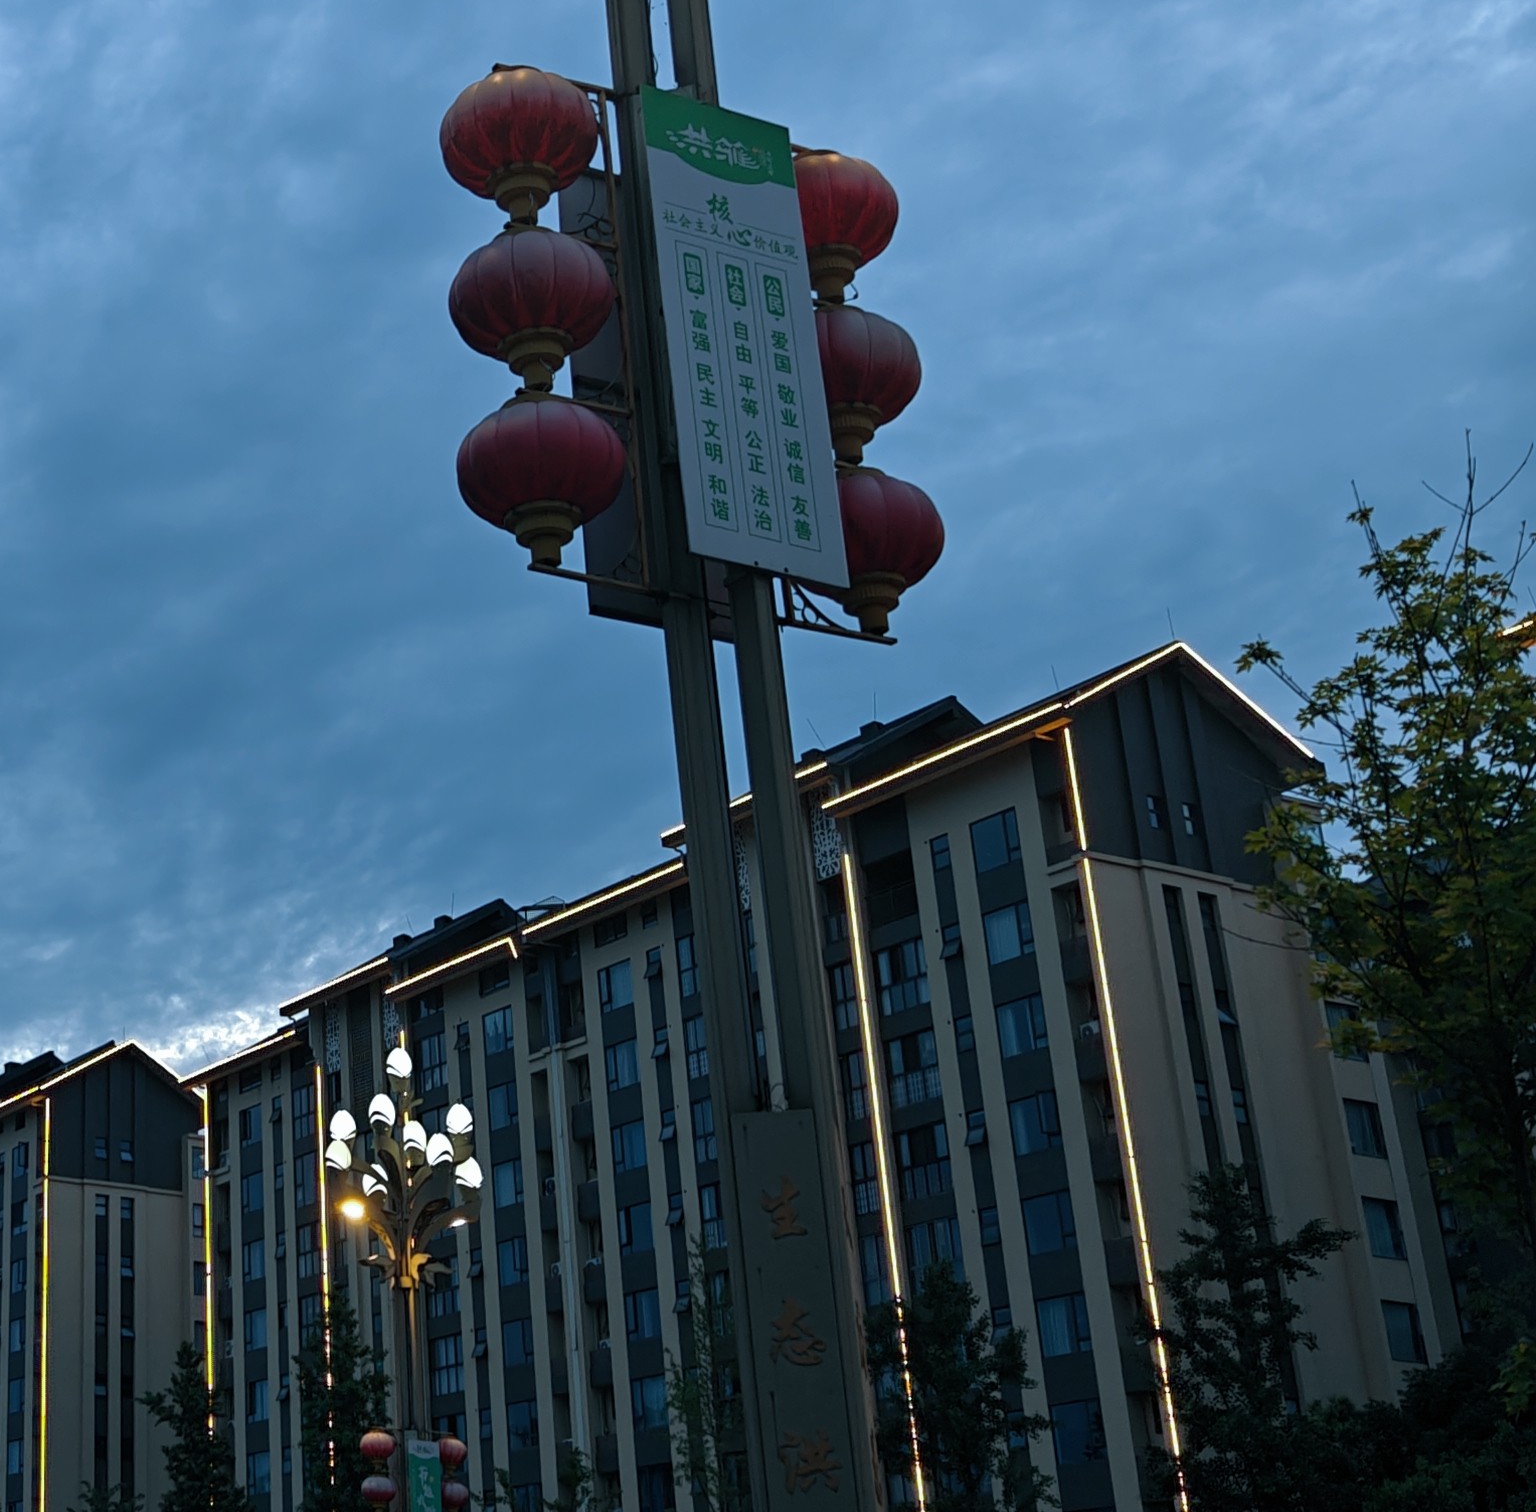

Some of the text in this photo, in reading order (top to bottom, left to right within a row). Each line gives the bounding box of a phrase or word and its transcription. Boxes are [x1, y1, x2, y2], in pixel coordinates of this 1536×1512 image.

[685, 255, 704, 295] 国家
[726, 266, 745, 306] 社会
[764, 276, 784, 317] 公民
[689, 309, 730, 522] 富强 民主 文明 和谐
[734, 320, 773, 532] 自由 平等 公正 法治
[771, 330, 812, 541] 爱国 敬业 诚信 友善
